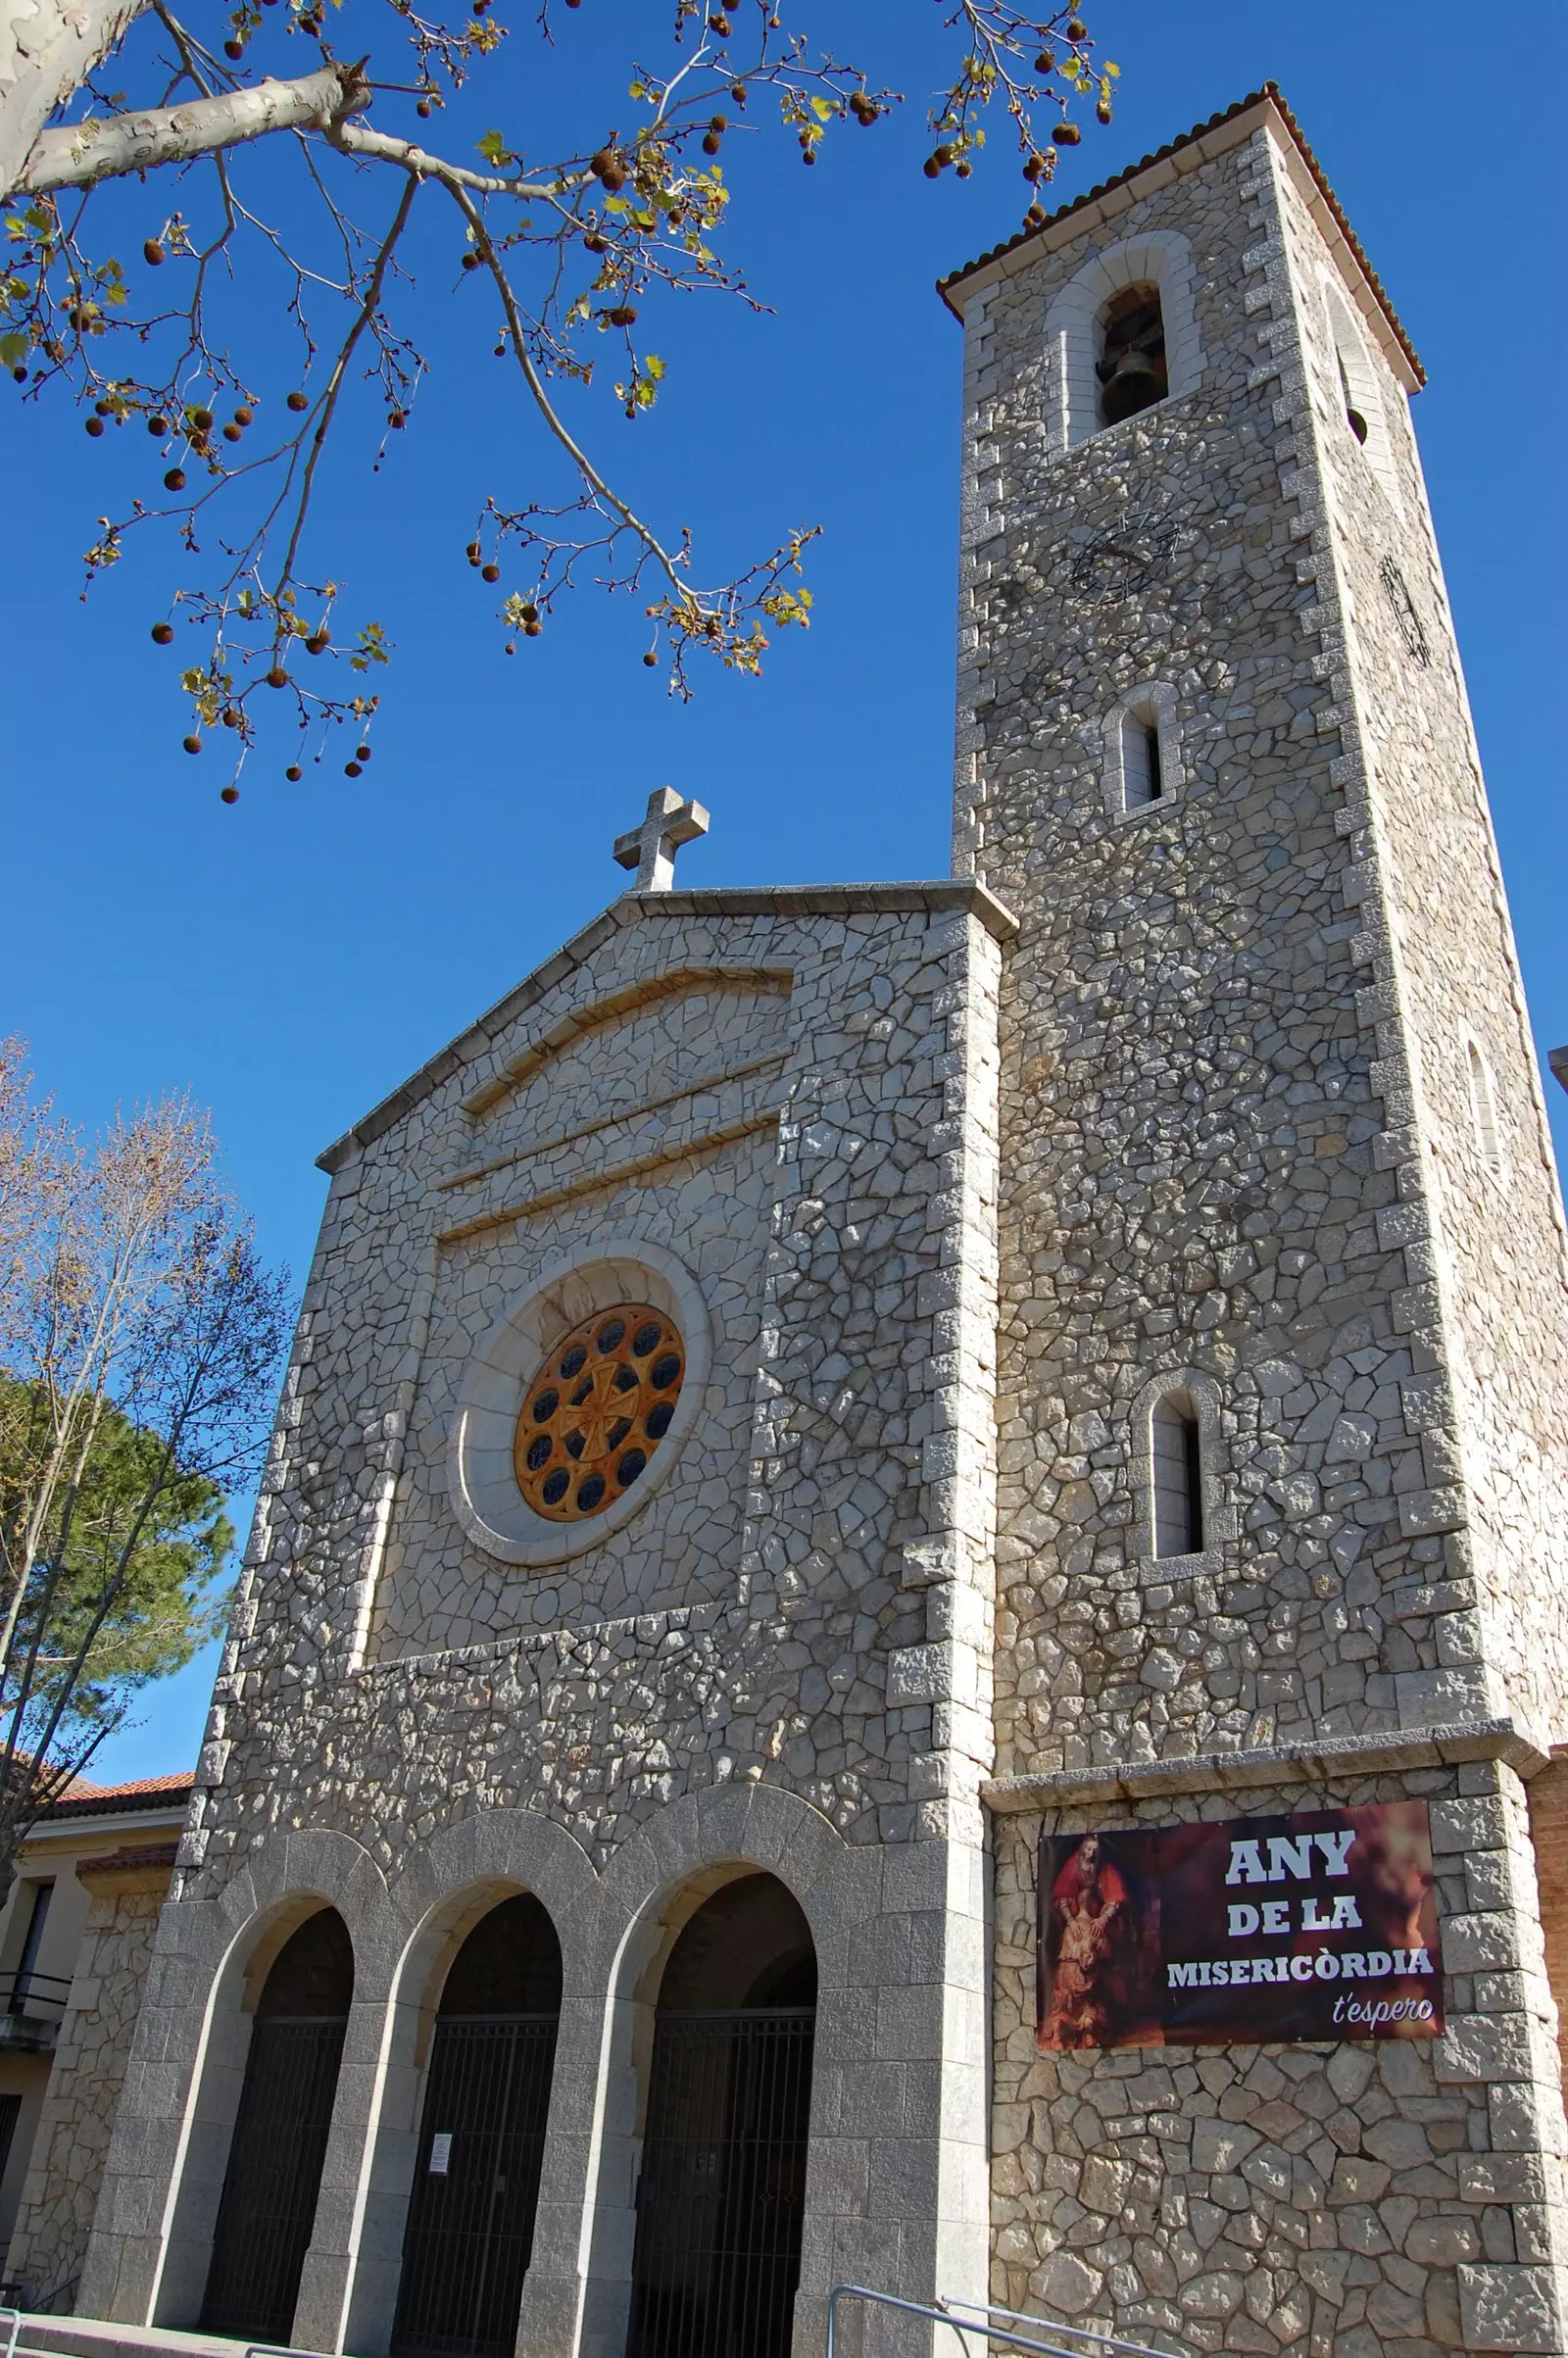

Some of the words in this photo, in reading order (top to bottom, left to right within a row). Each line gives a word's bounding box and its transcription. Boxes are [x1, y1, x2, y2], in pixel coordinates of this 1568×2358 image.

[1225, 1830, 1355, 1885] ANY
[1228, 1901, 1290, 1936] DE
[1301, 1895, 1361, 1931] LA
[1167, 1947, 1434, 1987] MISERICÒRDIA
[1334, 1992, 1433, 2030] t'espero
